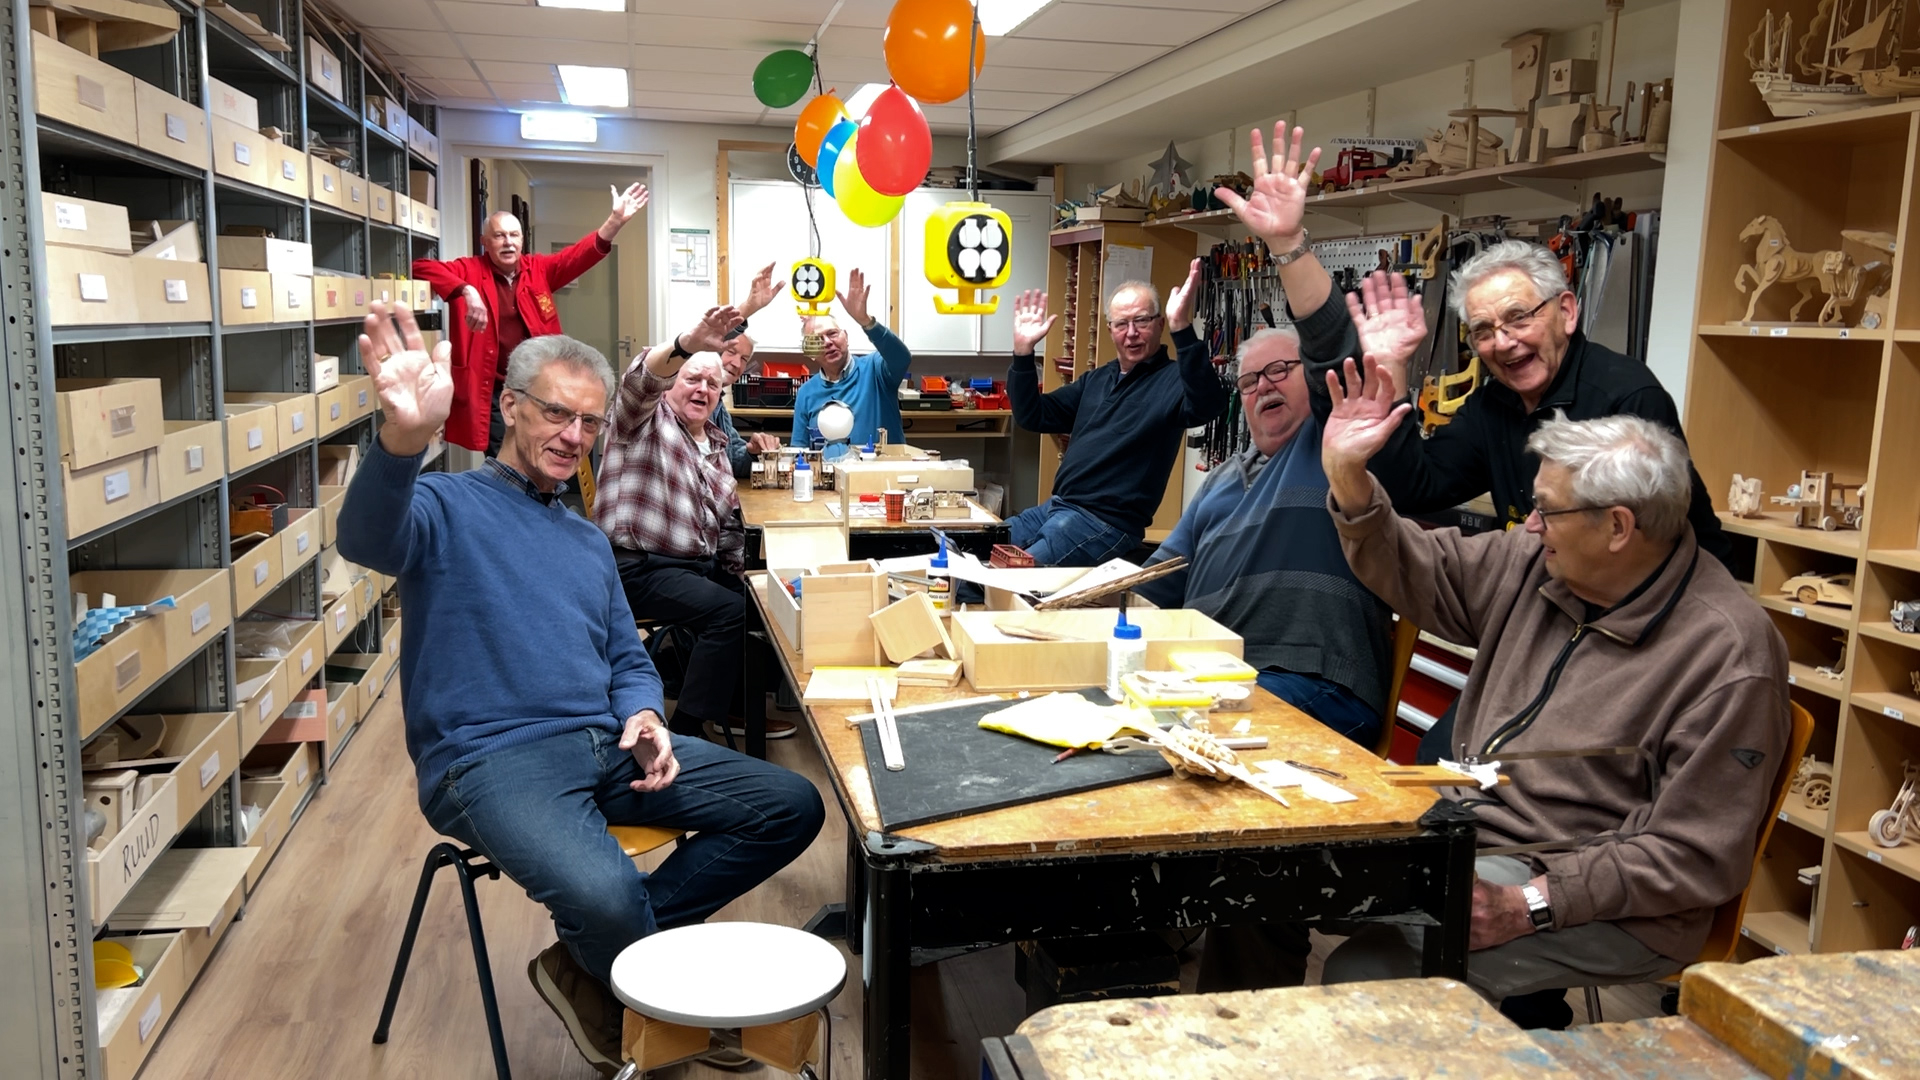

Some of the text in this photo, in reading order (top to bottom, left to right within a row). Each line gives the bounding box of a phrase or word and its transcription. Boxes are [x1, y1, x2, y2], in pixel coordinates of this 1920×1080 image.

[794, 156, 799, 164] 9
[1461, 515, 1481, 527] HBM
[122, 813, 160, 884] RUUD
